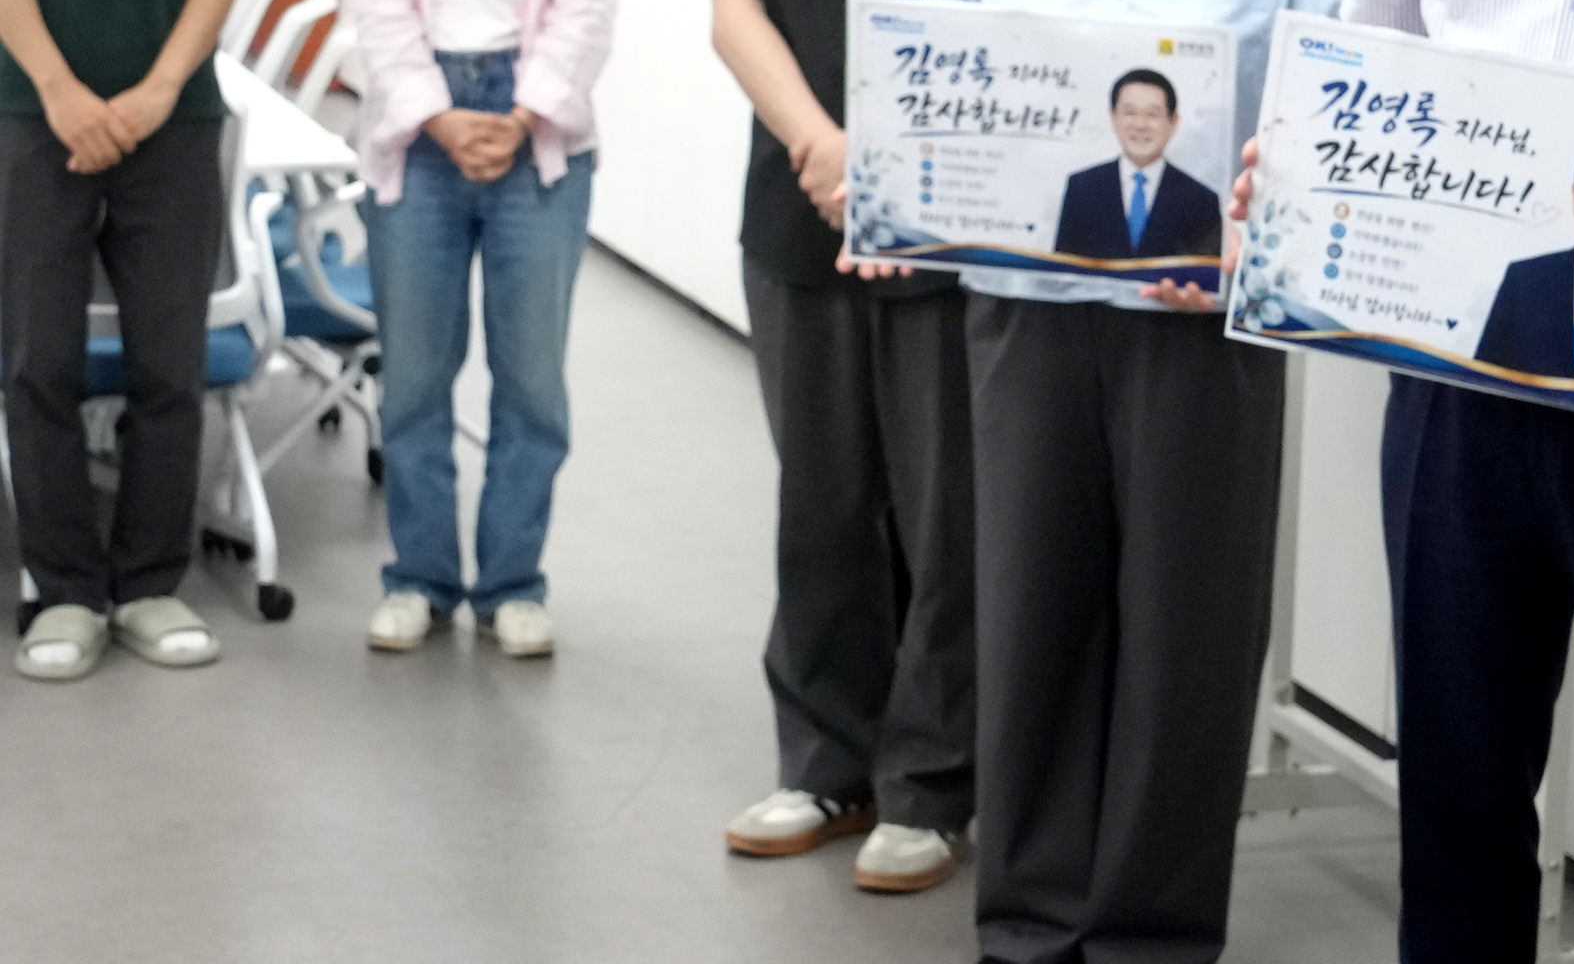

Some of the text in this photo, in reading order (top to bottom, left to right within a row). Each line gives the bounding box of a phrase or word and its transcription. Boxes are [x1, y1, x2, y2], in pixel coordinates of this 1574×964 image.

[892, 44, 998, 91] 김영록
[897, 91, 1080, 135] 감사합니다!
[1311, 79, 1536, 156] 김영록 지사님,
[1315, 139, 1535, 213] 감사합니다!
